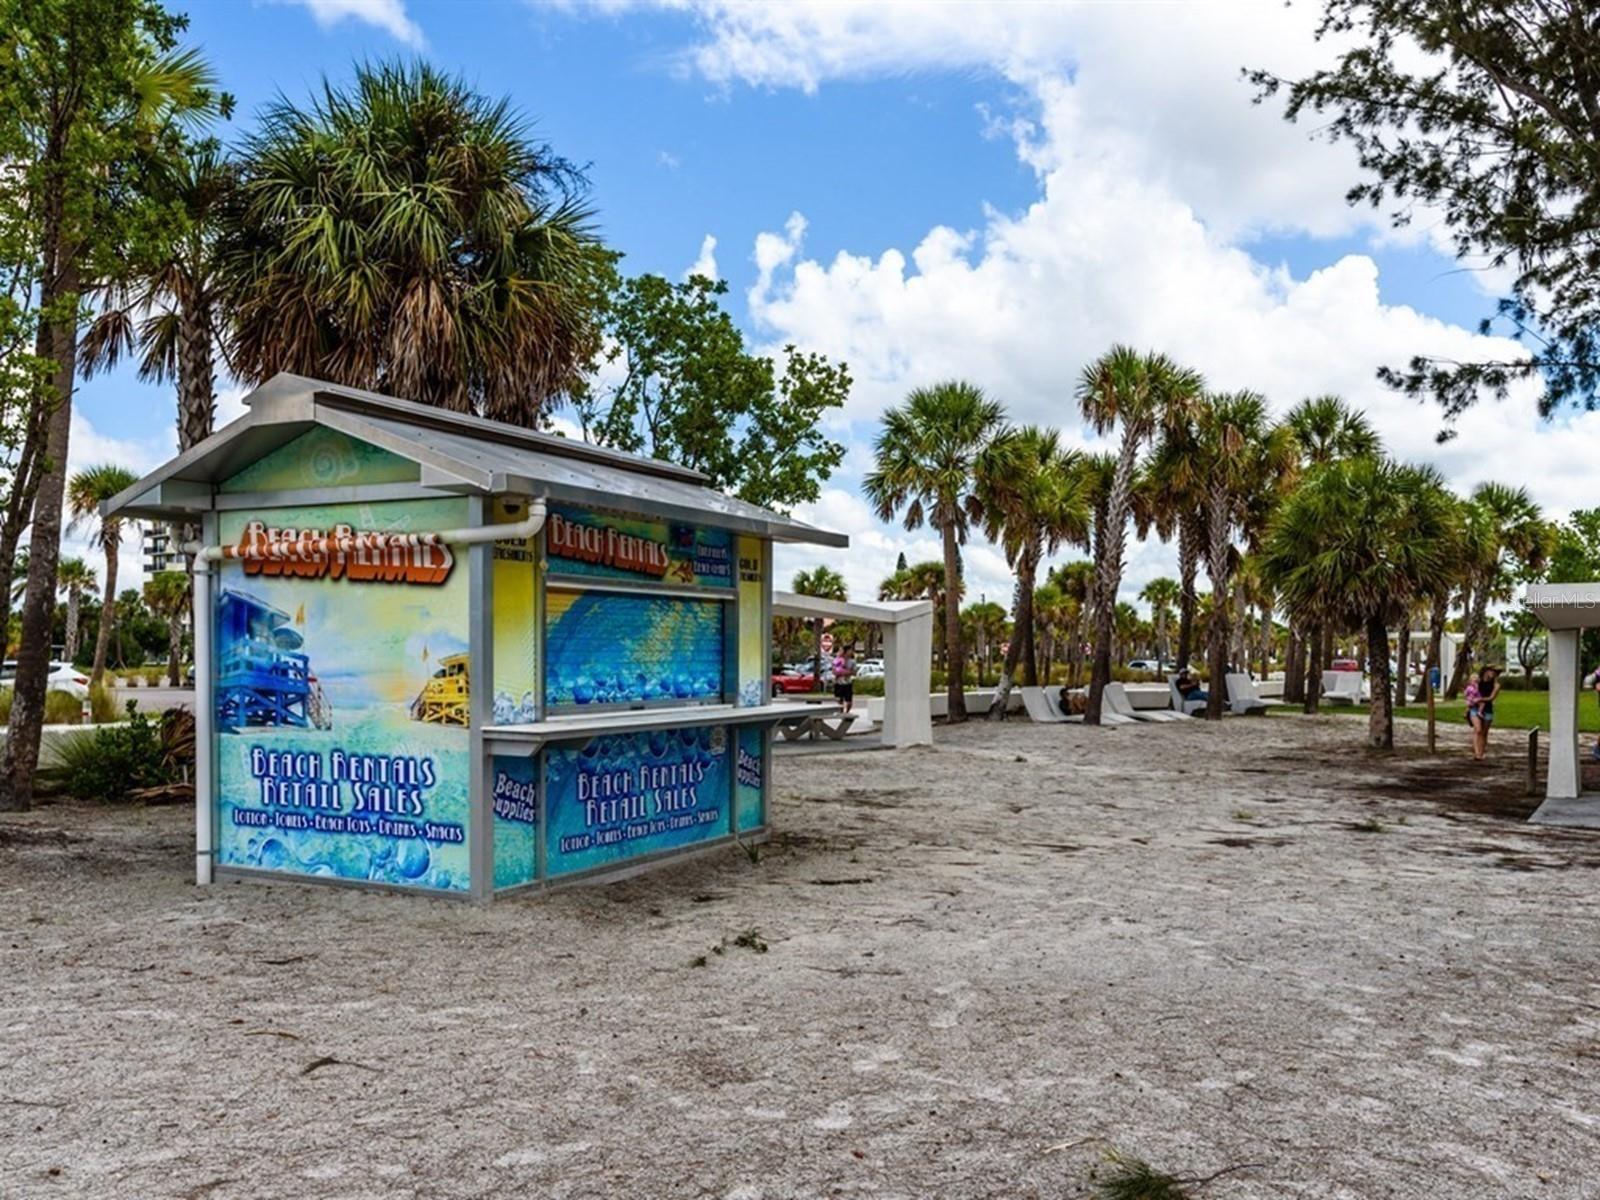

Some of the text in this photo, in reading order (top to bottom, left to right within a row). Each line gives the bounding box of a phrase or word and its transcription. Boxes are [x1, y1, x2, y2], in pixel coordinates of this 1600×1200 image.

[247, 521, 328, 565] BEACH
[551, 513, 604, 553] BEACH
[606, 527, 669, 568] RENTALS
[252, 748, 435, 786] BEACH RENTALS
[578, 762, 704, 800] BEACH RENTALS
[263, 777, 423, 815] RETAIL SALES
[493, 793, 535, 822] upplies
[496, 773, 535, 806] Beach
[587, 787, 697, 826] RETAIL SALES
